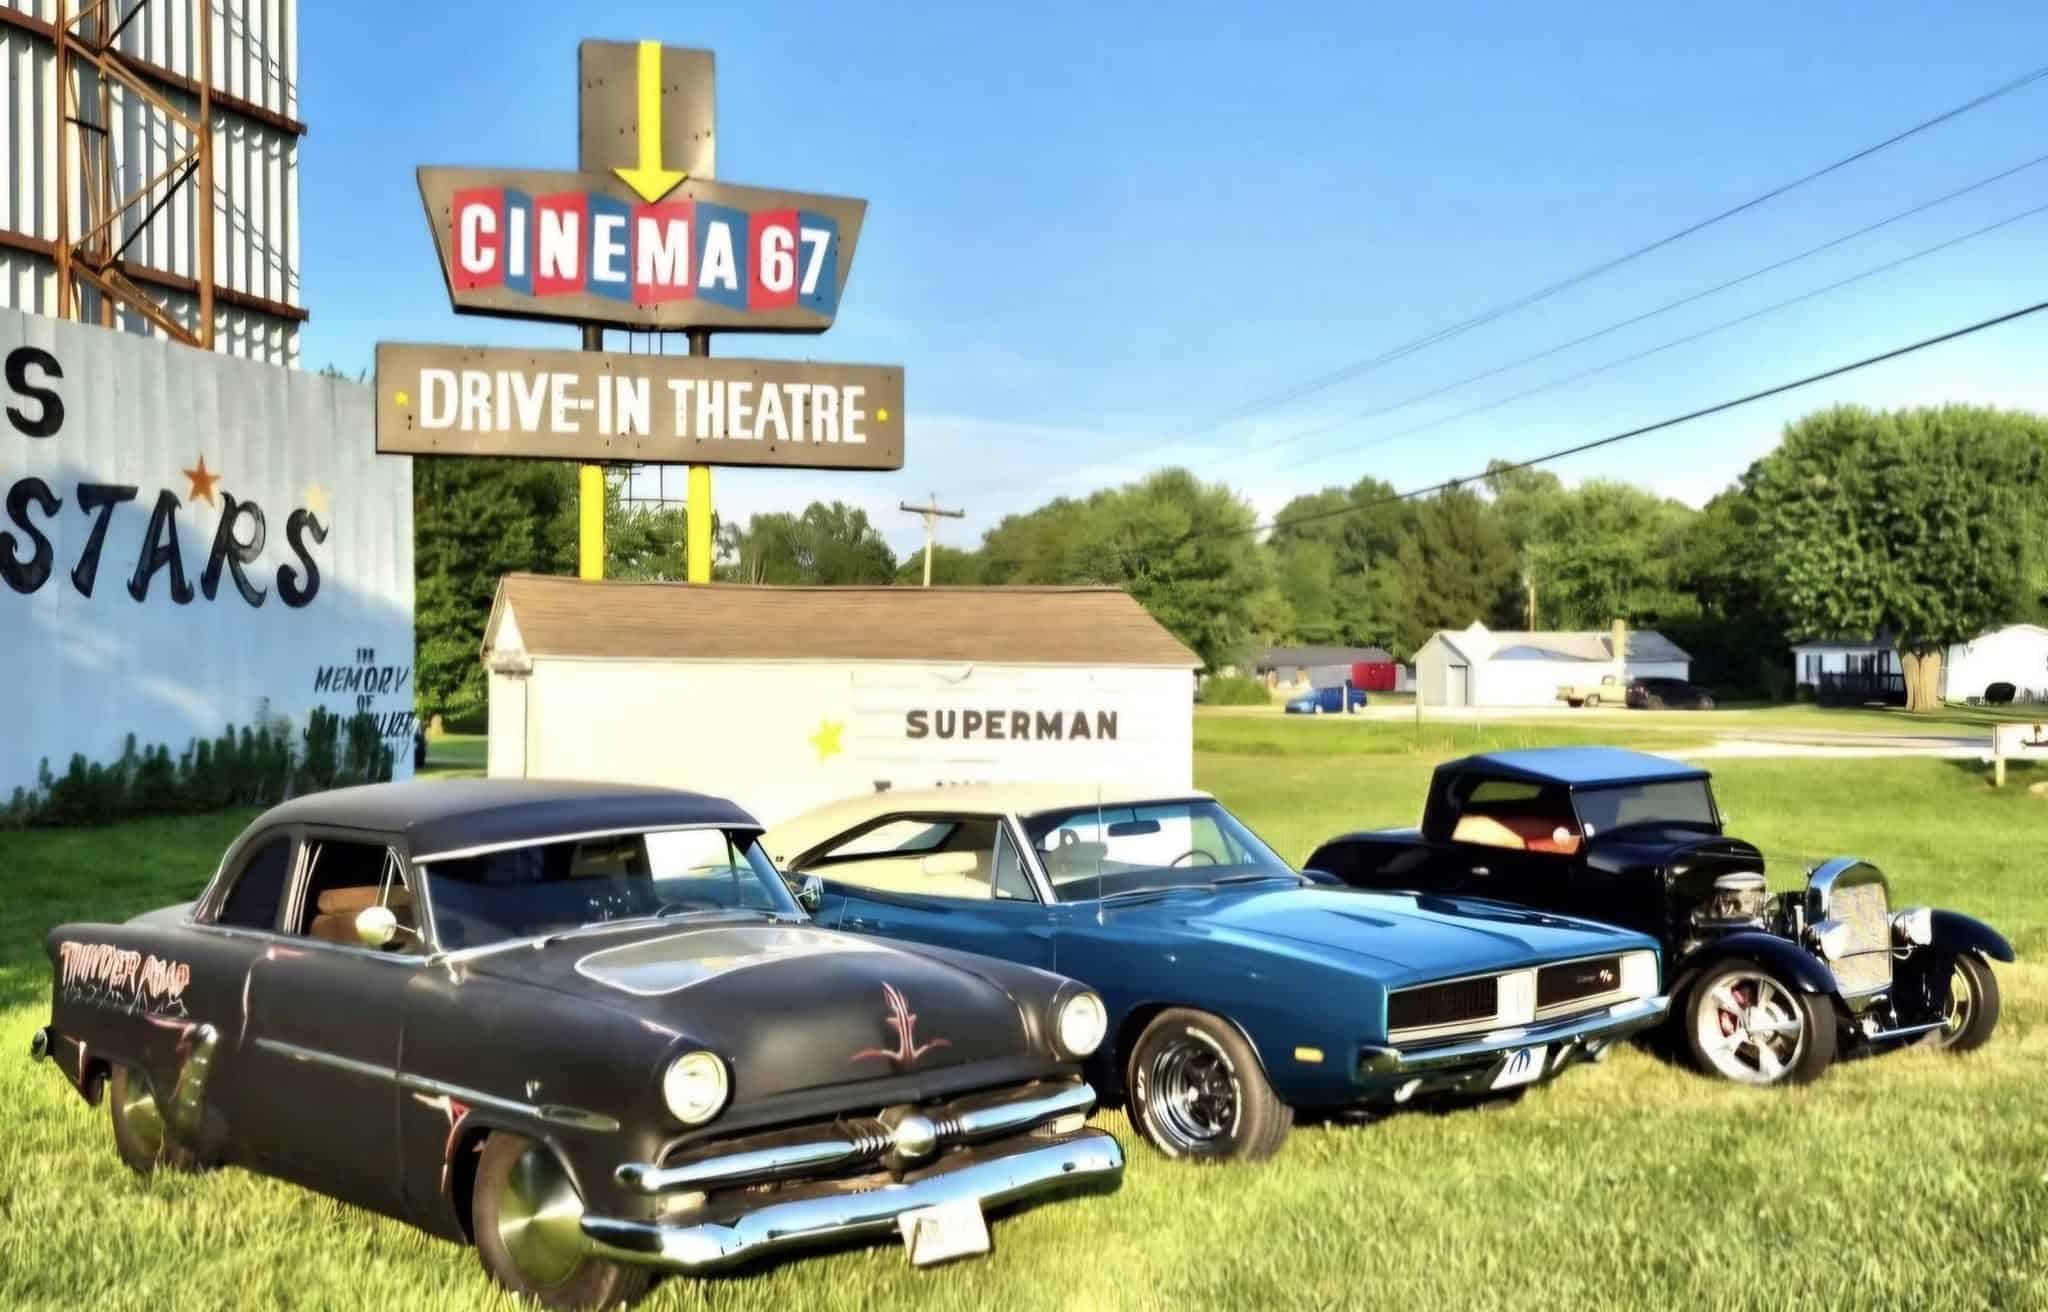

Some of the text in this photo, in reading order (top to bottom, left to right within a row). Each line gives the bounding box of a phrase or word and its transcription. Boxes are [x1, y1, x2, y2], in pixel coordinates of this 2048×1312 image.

[459, 202, 832, 295] CINEMA 67
[5, 345, 65, 439] S
[418, 367, 867, 444] DRIVE-IN THEATRE
[0, 476, 330, 609] STARS
[313, 664, 410, 694] MEMORY
[905, 709, 1119, 741] SUPERMAN
